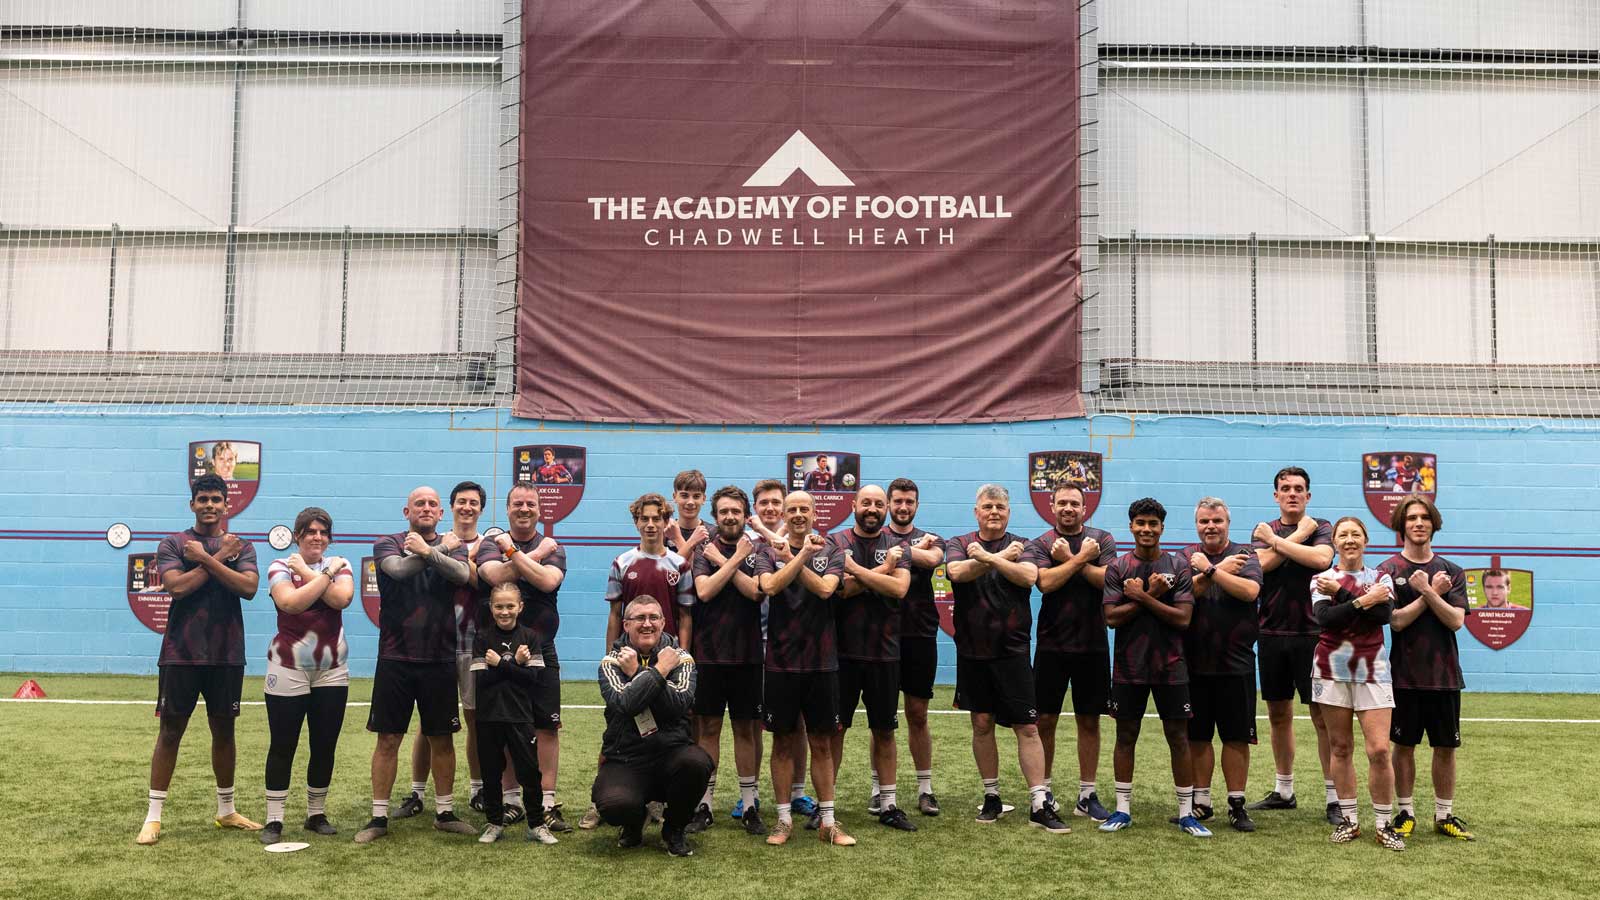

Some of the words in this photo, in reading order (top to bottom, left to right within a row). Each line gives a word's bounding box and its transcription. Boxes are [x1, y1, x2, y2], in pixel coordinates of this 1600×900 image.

[588, 197, 646, 220] THE
[653, 196, 799, 220] ACADEMY
[806, 195, 848, 219] OF
[855, 195, 1012, 219] FOOTBALL
[644, 227, 825, 246] CHADWELL
[848, 227, 955, 245] HEATH
